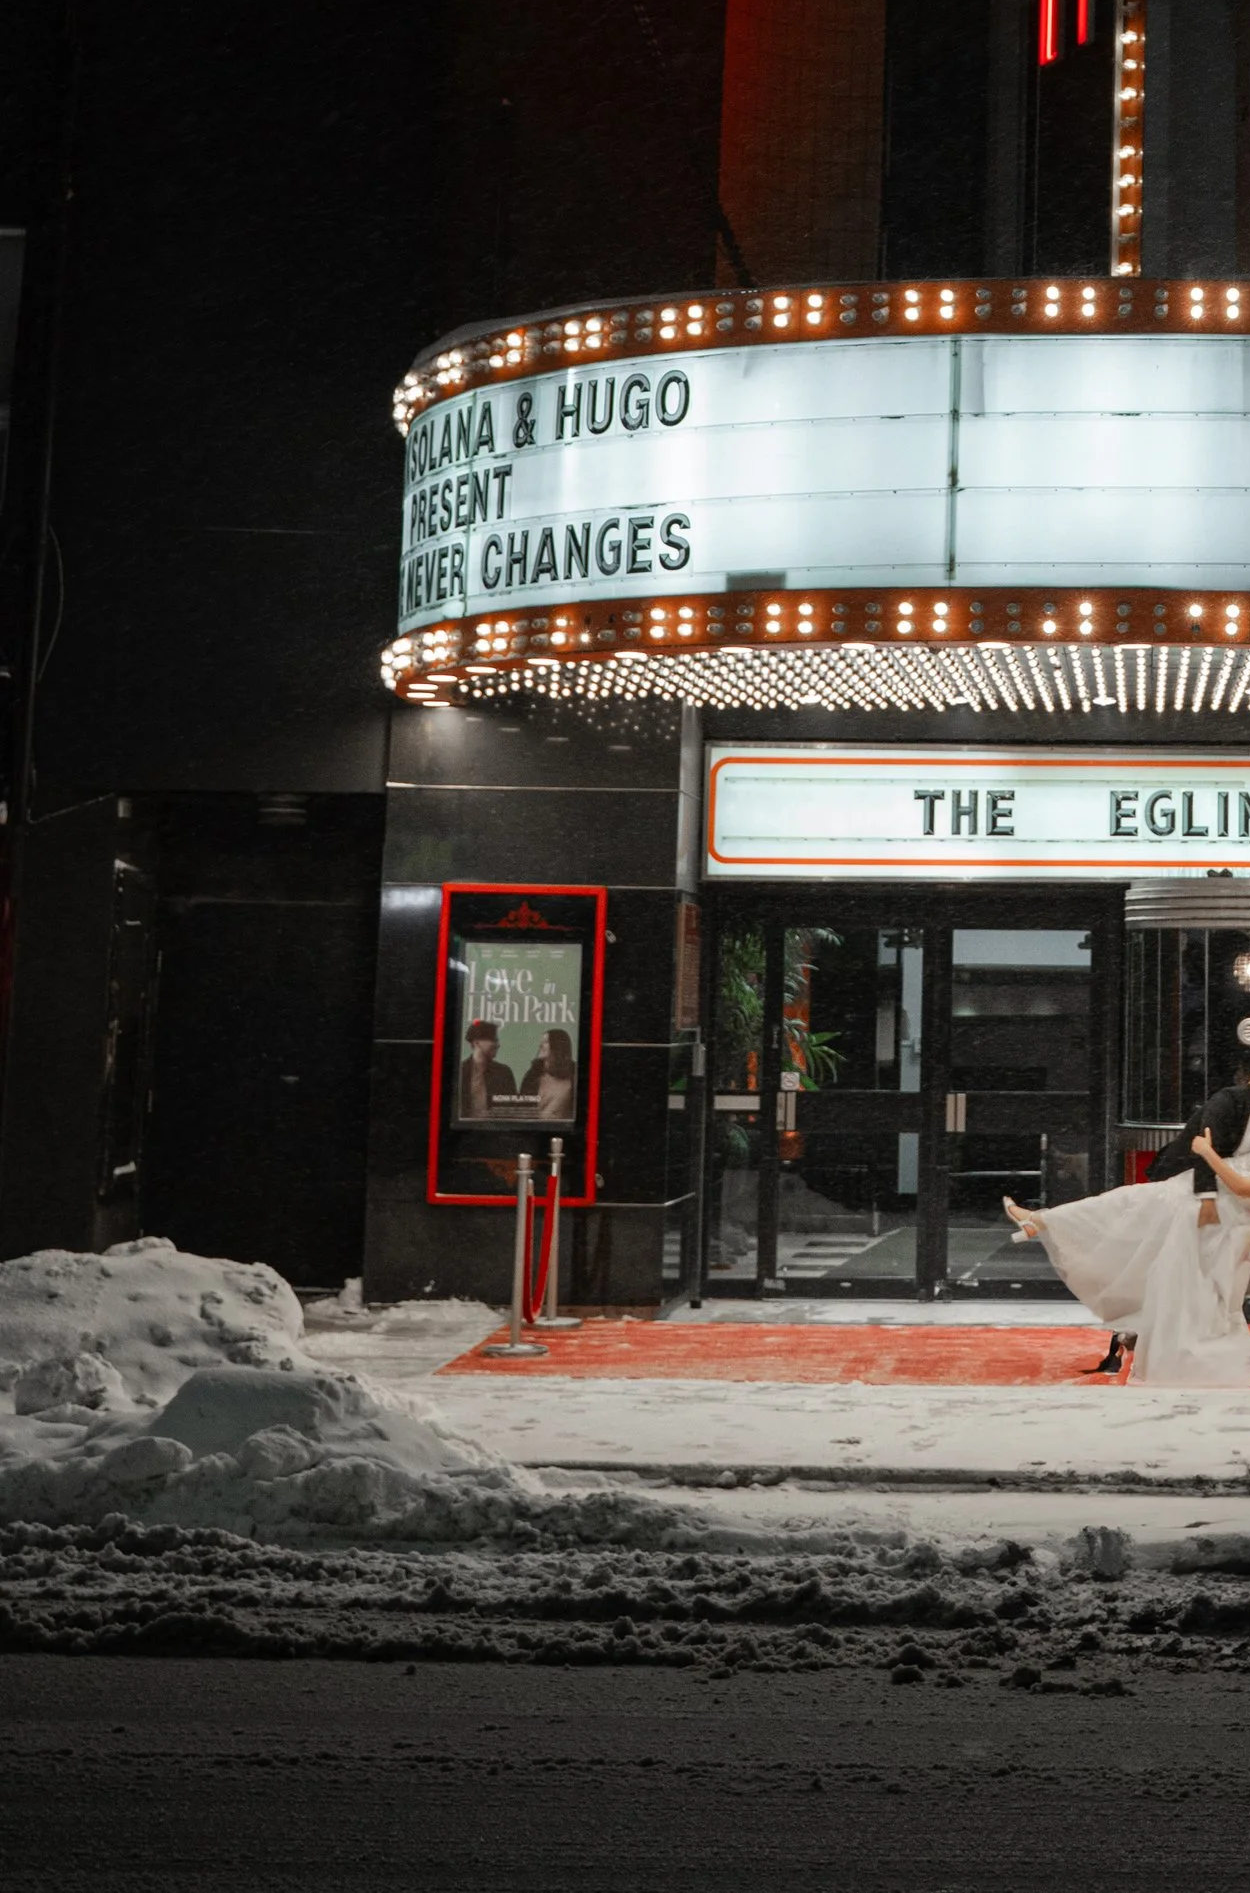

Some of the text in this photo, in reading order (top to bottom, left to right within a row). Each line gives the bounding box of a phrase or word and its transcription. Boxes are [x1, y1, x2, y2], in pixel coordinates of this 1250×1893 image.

[406, 370, 691, 484] SOLANA & HUGO
[410, 464, 513, 546] PRESENT
[406, 541, 465, 613] NEVER
[481, 513, 691, 589] CHANGES
[914, 789, 1015, 836] THE
[470, 961, 556, 994] Love in
[468, 994, 576, 1028] High Park
